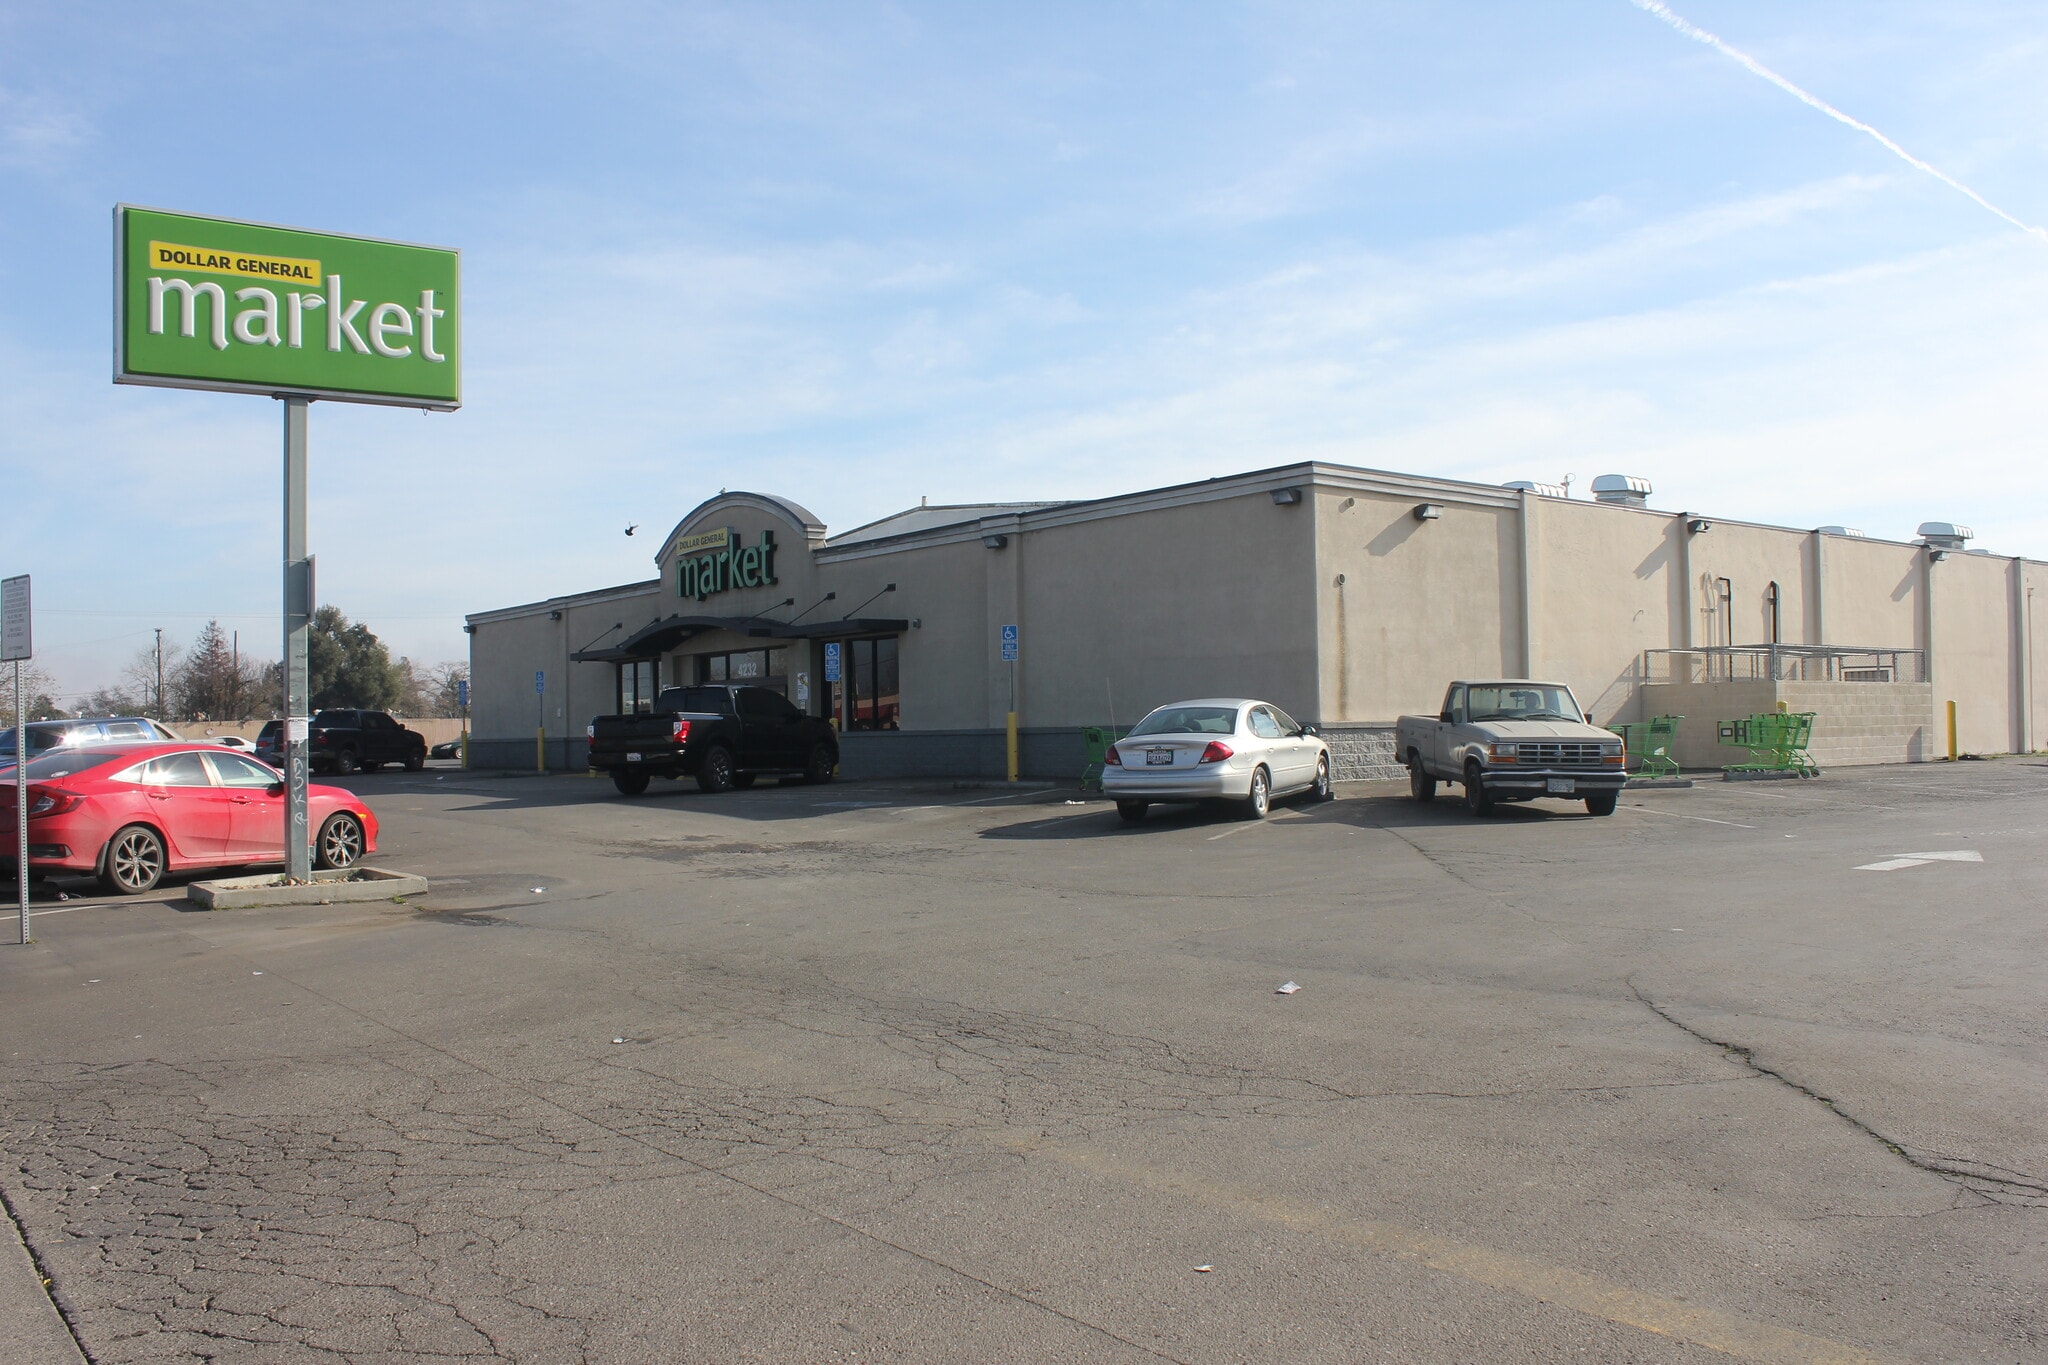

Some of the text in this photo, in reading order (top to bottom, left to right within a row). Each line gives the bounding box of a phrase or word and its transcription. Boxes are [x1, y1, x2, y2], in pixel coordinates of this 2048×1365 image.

[159, 249, 313, 279] DOLLAR GENERAL
[147, 274, 446, 363] market
[679, 533, 725, 550] DOLLAR GENERAL
[676, 530, 775, 601] market
[738, 662, 757, 677] 4232
